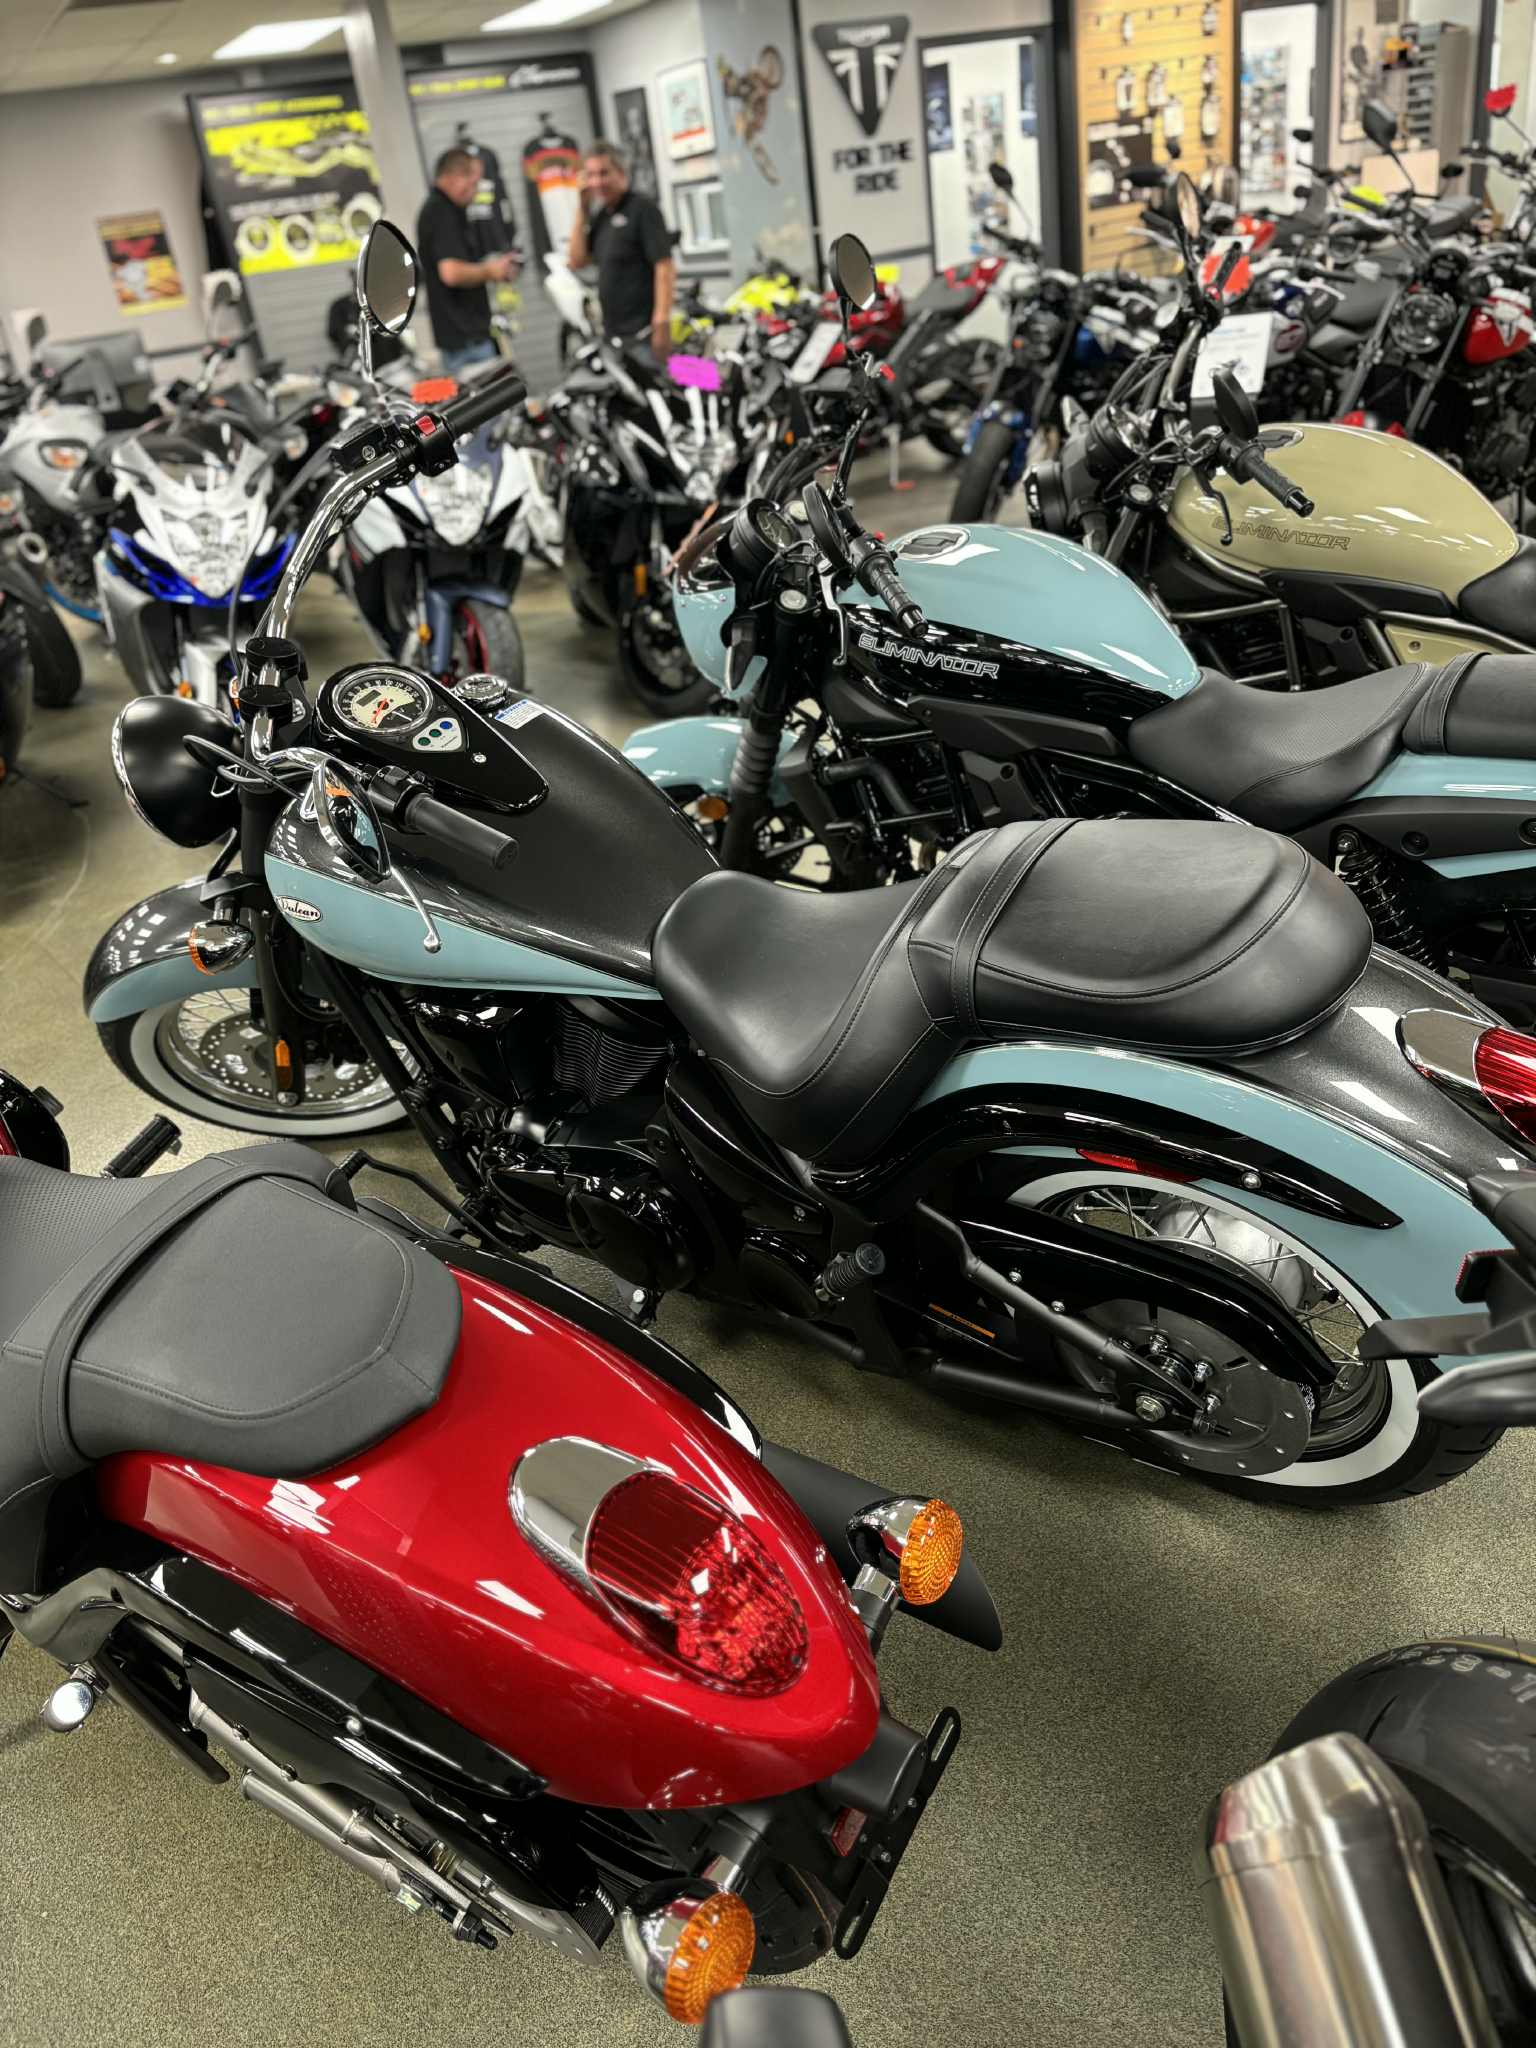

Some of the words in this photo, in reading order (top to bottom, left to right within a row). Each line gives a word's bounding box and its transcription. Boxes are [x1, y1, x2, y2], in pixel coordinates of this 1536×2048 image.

[833, 147, 871, 172] FOR
[878, 140, 914, 163] THE
[855, 171, 898, 192] RIDE
[858, 633, 1000, 679] ELIMINATOR
[280, 896, 319, 918] Vulcan
